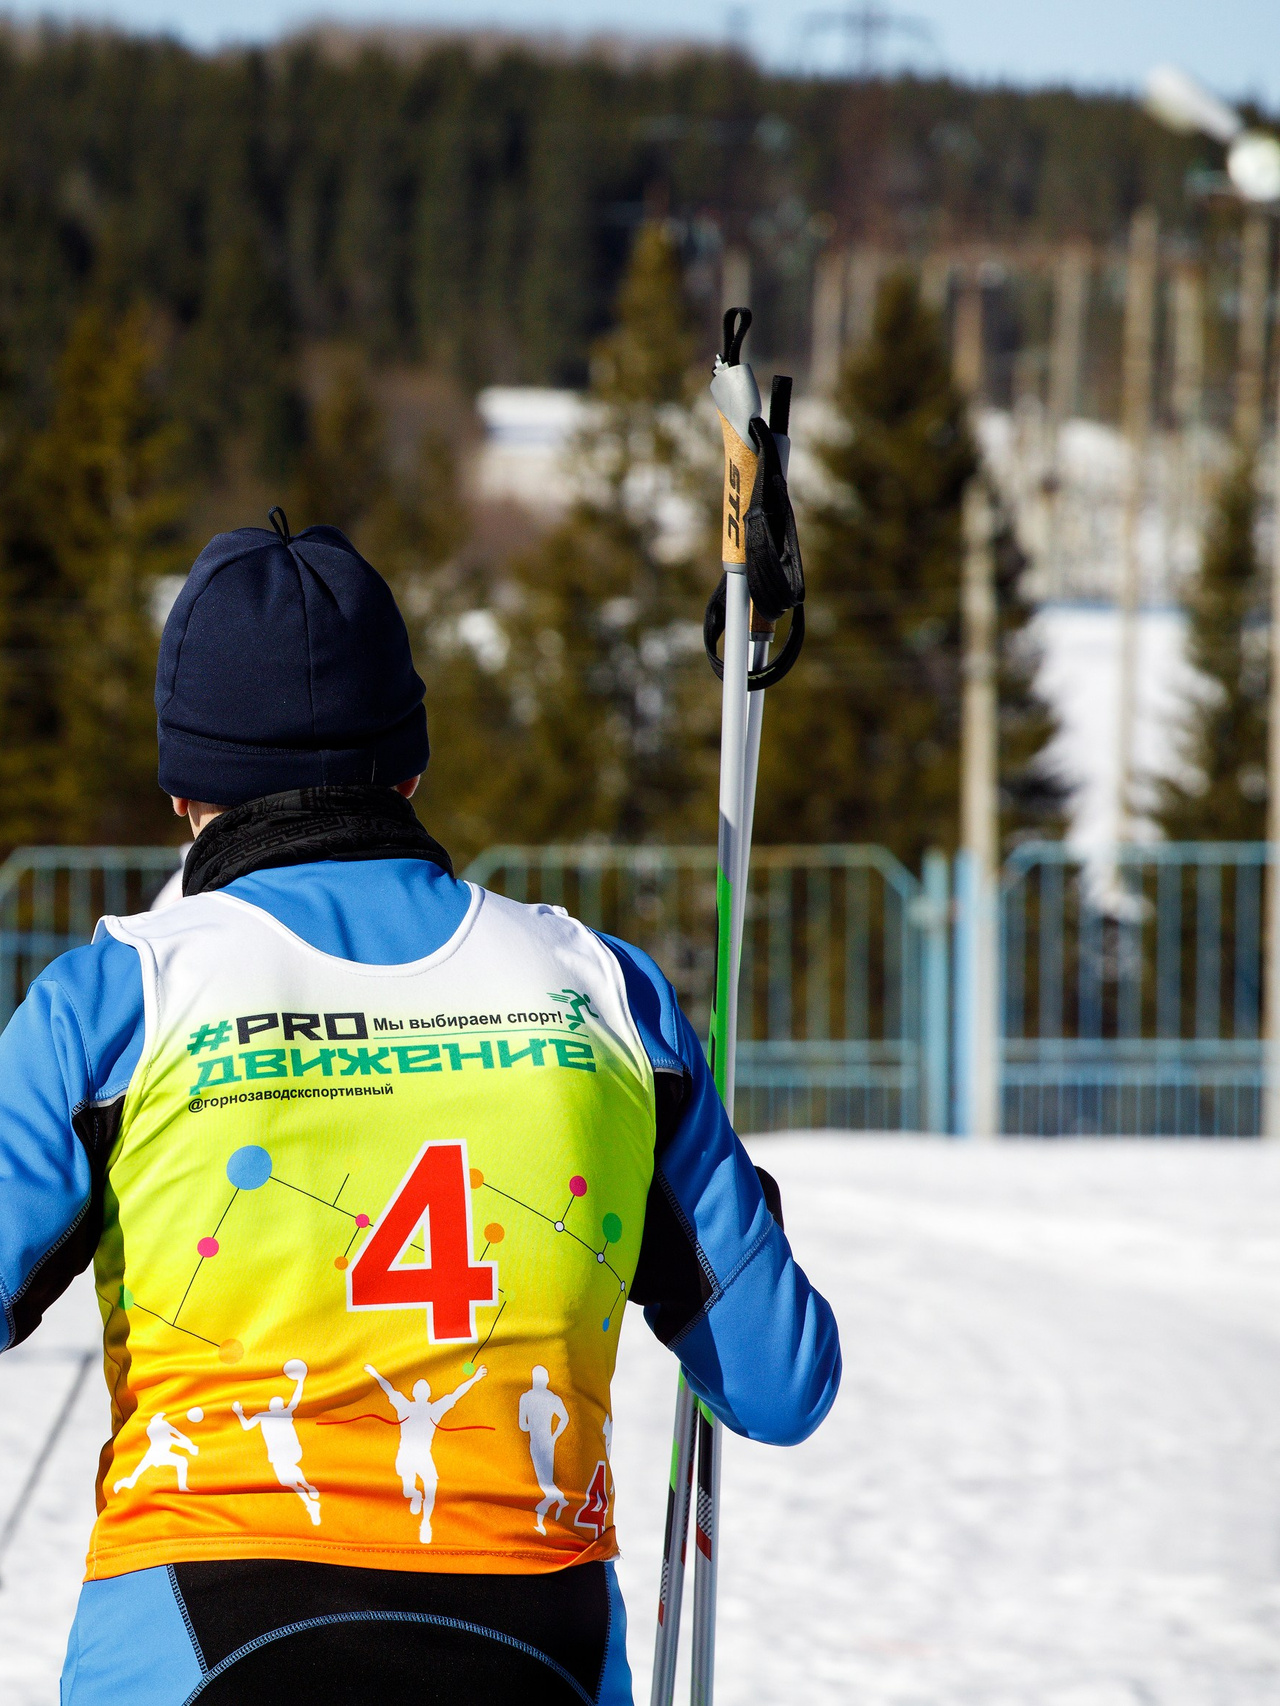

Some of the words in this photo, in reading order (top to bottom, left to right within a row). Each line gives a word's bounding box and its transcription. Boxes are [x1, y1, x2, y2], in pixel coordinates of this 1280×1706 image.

[728, 458, 740, 549] STC
[187, 1012, 369, 1056] #PRO
[373, 1017, 404, 1031] Мы
[409, 1013, 502, 1030] выбираем
[507, 1010, 564, 1025] спорт!
[188, 1083, 394, 1113] @горнозаводскспортивный
[346, 1139, 498, 1345] 4
[574, 1461, 609, 1540] 4
